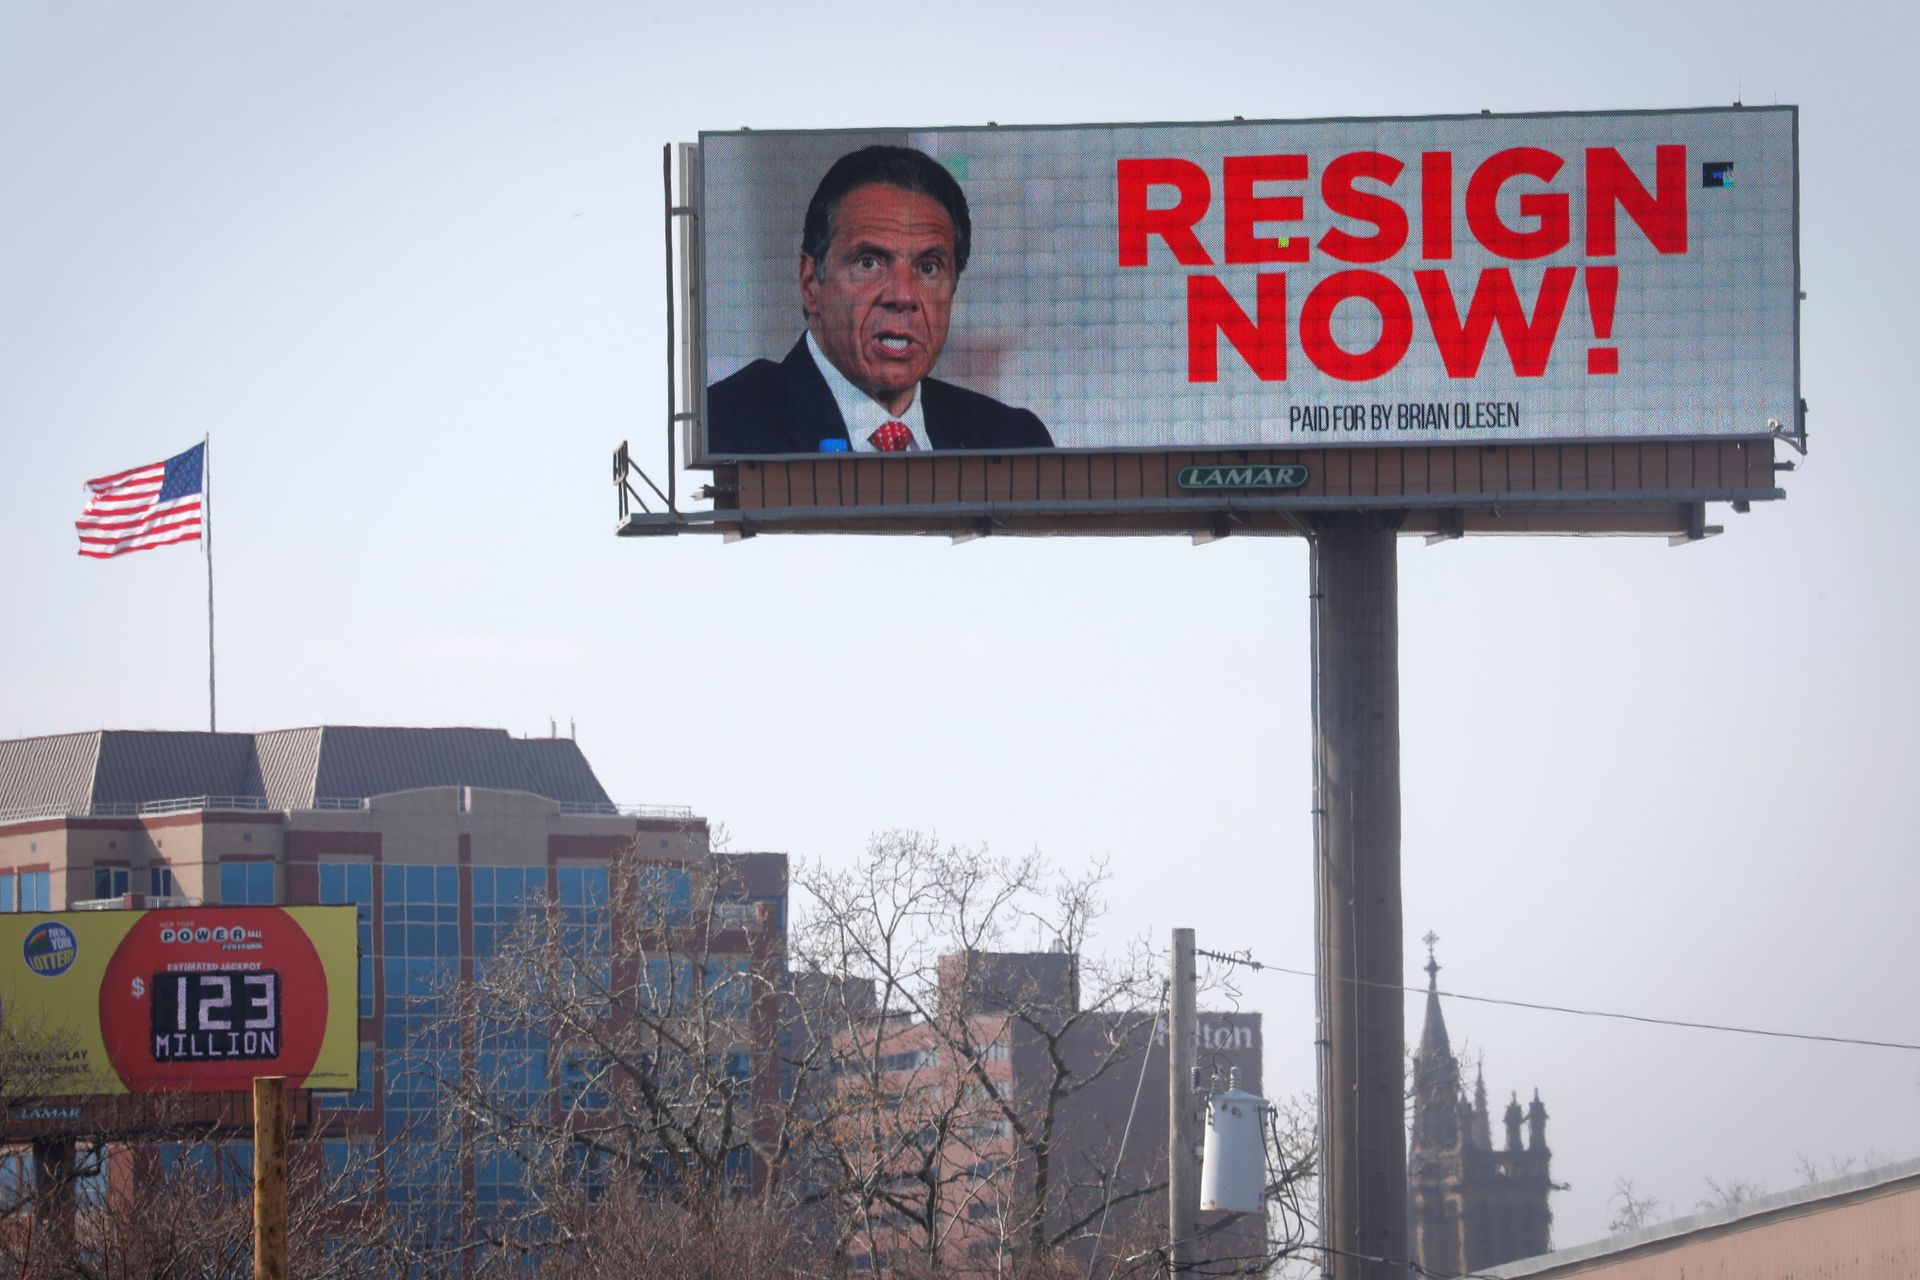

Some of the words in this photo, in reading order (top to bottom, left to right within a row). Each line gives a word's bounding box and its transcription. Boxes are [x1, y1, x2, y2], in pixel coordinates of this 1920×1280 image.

[1117, 144, 1688, 267] RESIGN
[1187, 266, 1619, 383] NOW!
[1290, 405, 1329, 432] PAID
[1333, 404, 1366, 431] FOR
[1371, 403, 1393, 430] BY
[1397, 402, 1450, 430] BRIAN
[1454, 401, 1520, 429] OLESEN
[1188, 467, 1295, 486] LAMAR
[29, 948, 75, 971] LOTTERY
[167, 962, 219, 972] ESTIMATED
[220, 961, 263, 971] JACKPOT
[177, 975, 275, 1030] 123
[155, 1030, 276, 1058] MILLION
[21, 1107, 82, 1119] LAMAR
